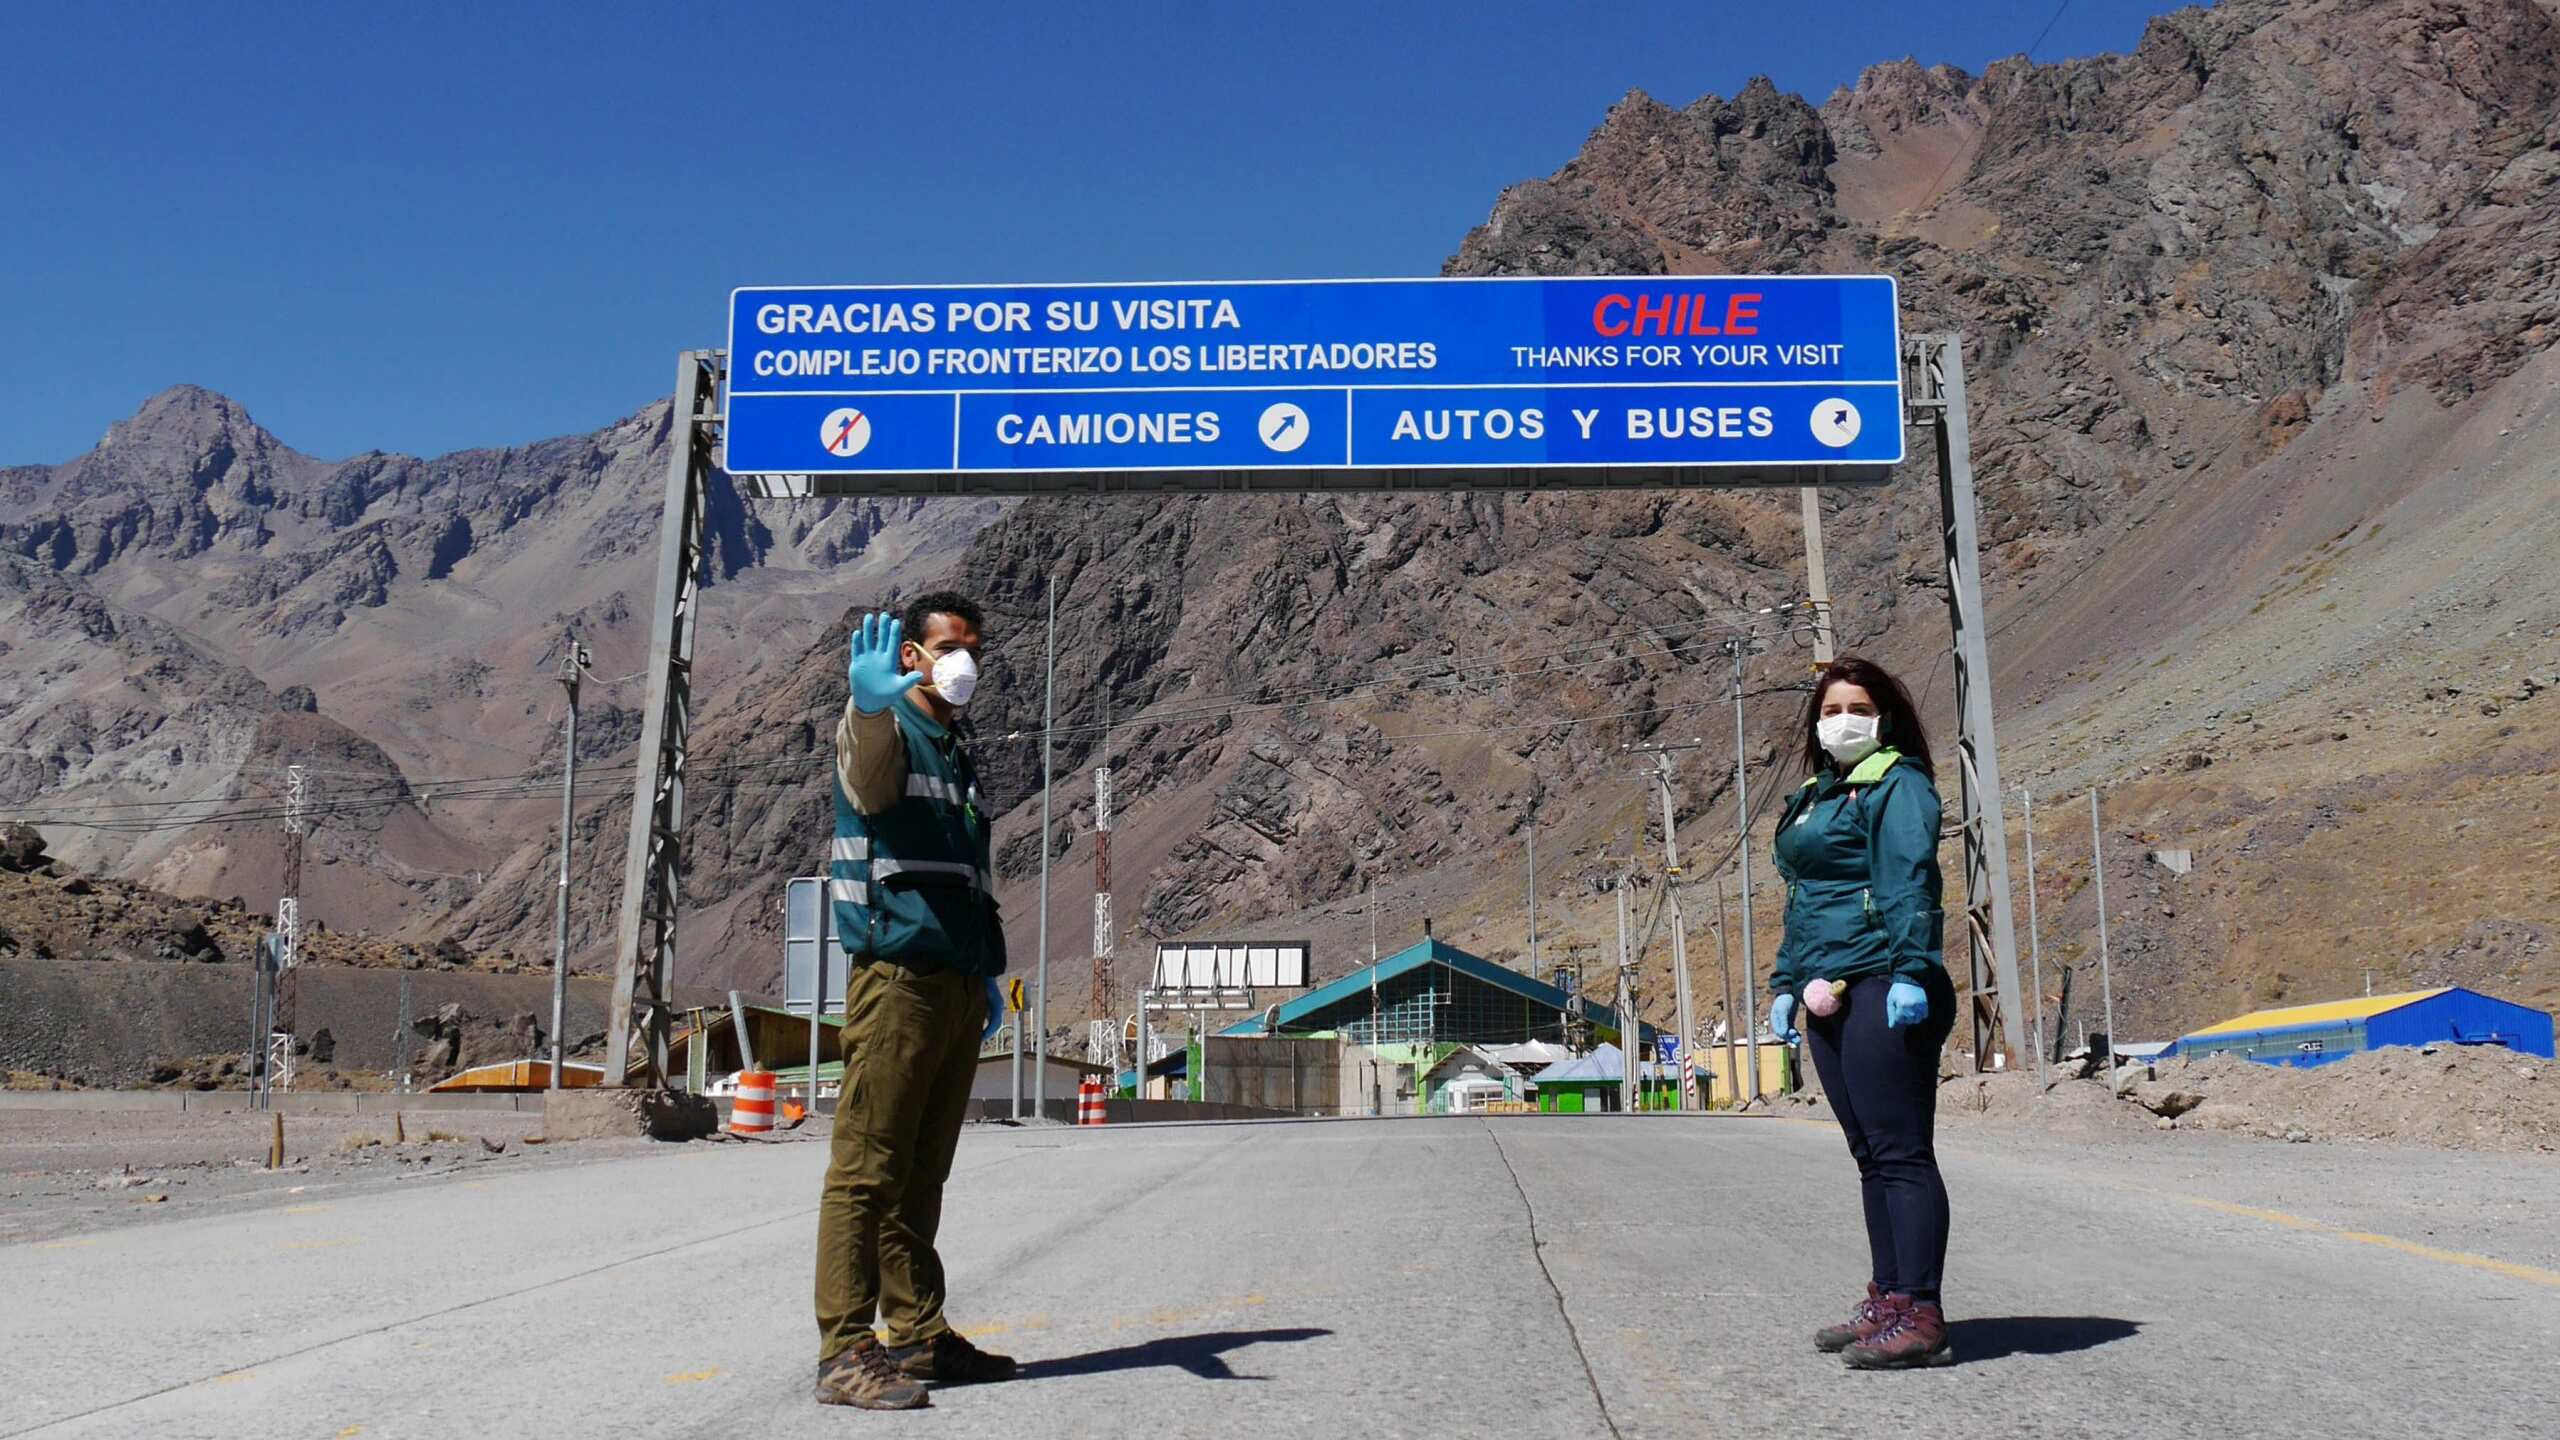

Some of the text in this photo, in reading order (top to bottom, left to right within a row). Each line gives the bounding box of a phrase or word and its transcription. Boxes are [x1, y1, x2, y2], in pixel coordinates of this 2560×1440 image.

[756, 299, 1241, 334] GRACIAS POR SU VISITA
[1593, 293, 1762, 337] CHILE
[754, 342, 1437, 377] COMPLEJO FRONTERIZO LOS LIBERTADORES
[1511, 344, 1844, 367] THANKS FOR YOUR VISIT
[996, 411, 1221, 445] CAMIONES
[1391, 406, 1774, 441] AUTOS Y BUSES
